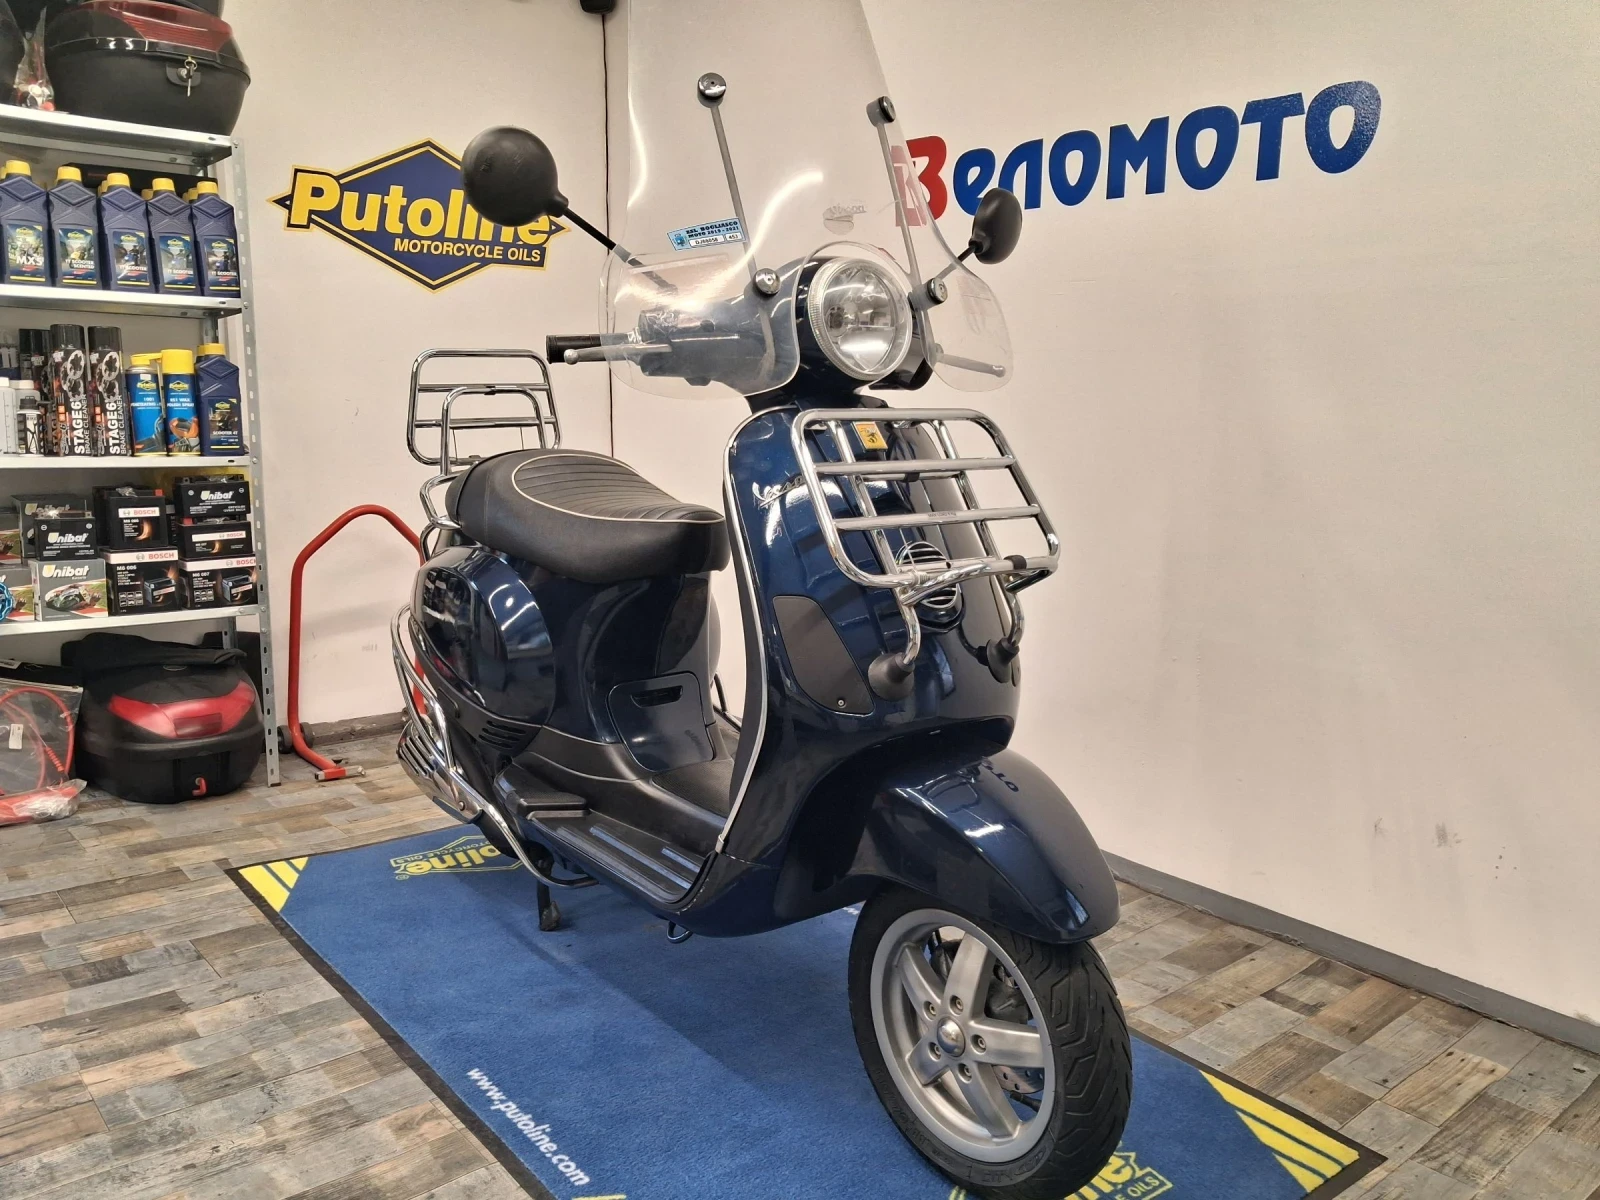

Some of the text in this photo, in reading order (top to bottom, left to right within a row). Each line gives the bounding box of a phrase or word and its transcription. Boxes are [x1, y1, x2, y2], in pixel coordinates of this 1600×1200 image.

[394, 237, 541, 262] MOTORCYCLE OILS
[71, 401, 85, 454] STAGE6
[106, 401, 120, 454] STAGE6
[117, 394, 127, 455] BRAKE CLEANER
[200, 490, 233, 501] Unibat
[47, 532, 88, 544] Unibat
[148, 552, 174, 560] BOSCH
[42, 564, 90, 578] Unibat
[466, 1067, 591, 1187] www.putoline.com
[1127, 1175, 1161, 1198] OILS
